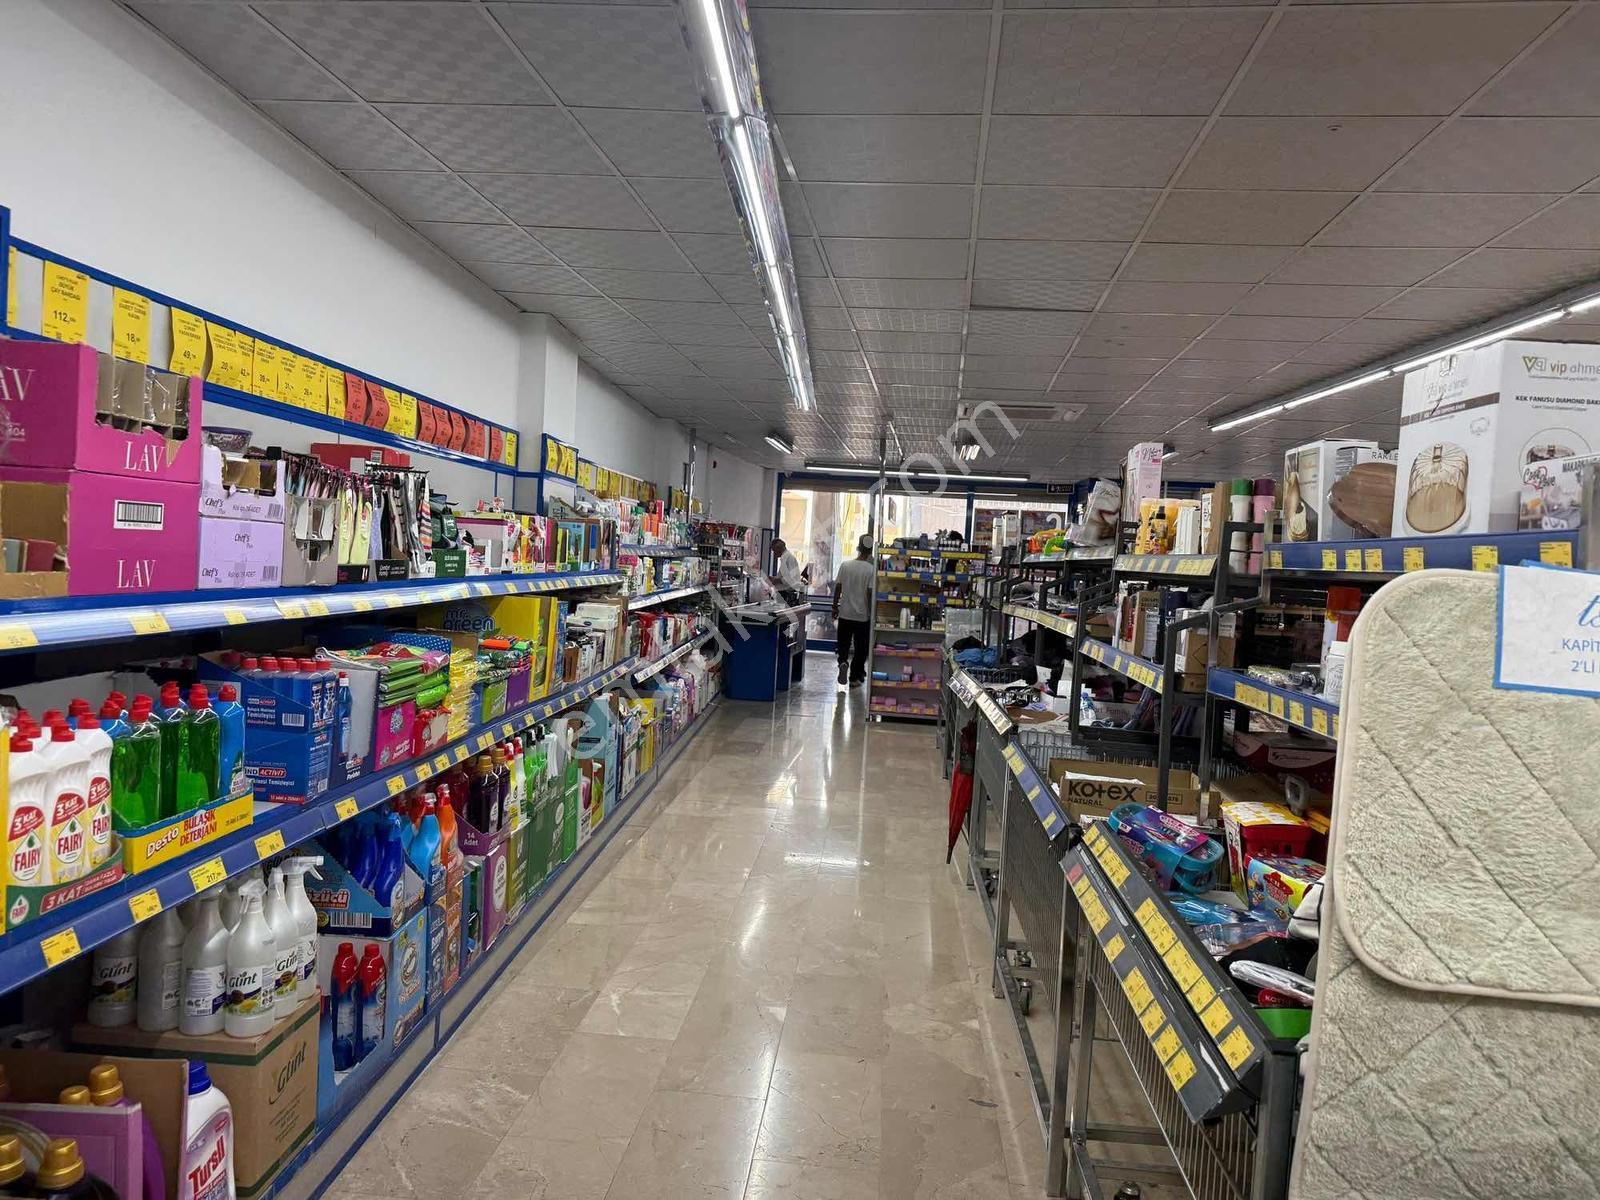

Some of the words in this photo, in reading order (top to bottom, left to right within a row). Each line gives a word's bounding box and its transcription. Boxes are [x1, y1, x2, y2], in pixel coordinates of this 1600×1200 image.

[1550, 361, 1568, 376] vip
[124, 441, 165, 473] LAV
[116, 559, 157, 589] LAV
[259, 769, 285, 777] ACTIVIT
[90, 787, 98, 799] 3
[56, 803, 64, 814] 3
[64, 796, 79, 809] KAT
[14, 818, 22, 828] 3
[22, 810, 38, 822] KAT
[183, 808, 216, 831] BULAŞIK
[57, 830, 84, 855] FAIRY
[146, 826, 179, 860] Desto
[179, 821, 218, 847] DETERJANI
[14, 847, 42, 872] FAIRY
[46, 898, 57, 910] 3
[56, 884, 84, 905] KAT
[100, 962, 133, 979] Glint
[276, 954, 298, 972] Glin
[229, 971, 258, 988] Glint
[276, 1041, 307, 1093] Glint
